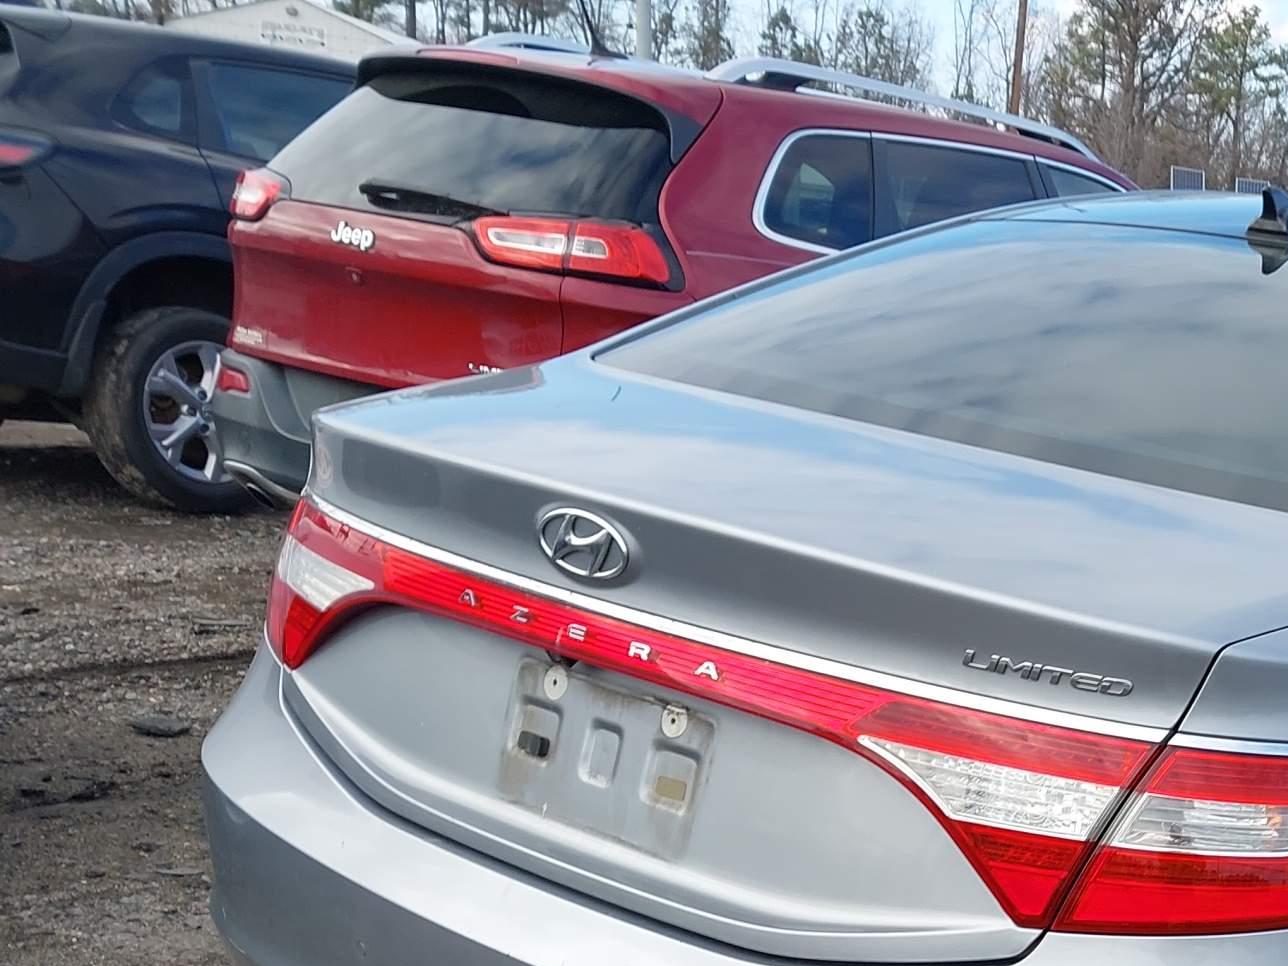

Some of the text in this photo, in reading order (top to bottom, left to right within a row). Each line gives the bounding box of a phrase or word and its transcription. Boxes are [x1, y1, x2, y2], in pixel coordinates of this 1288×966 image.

[330, 220, 375, 252] Jeep
[458, 588, 720, 681] AZERA
[962, 648, 1134, 697] LIMITED
